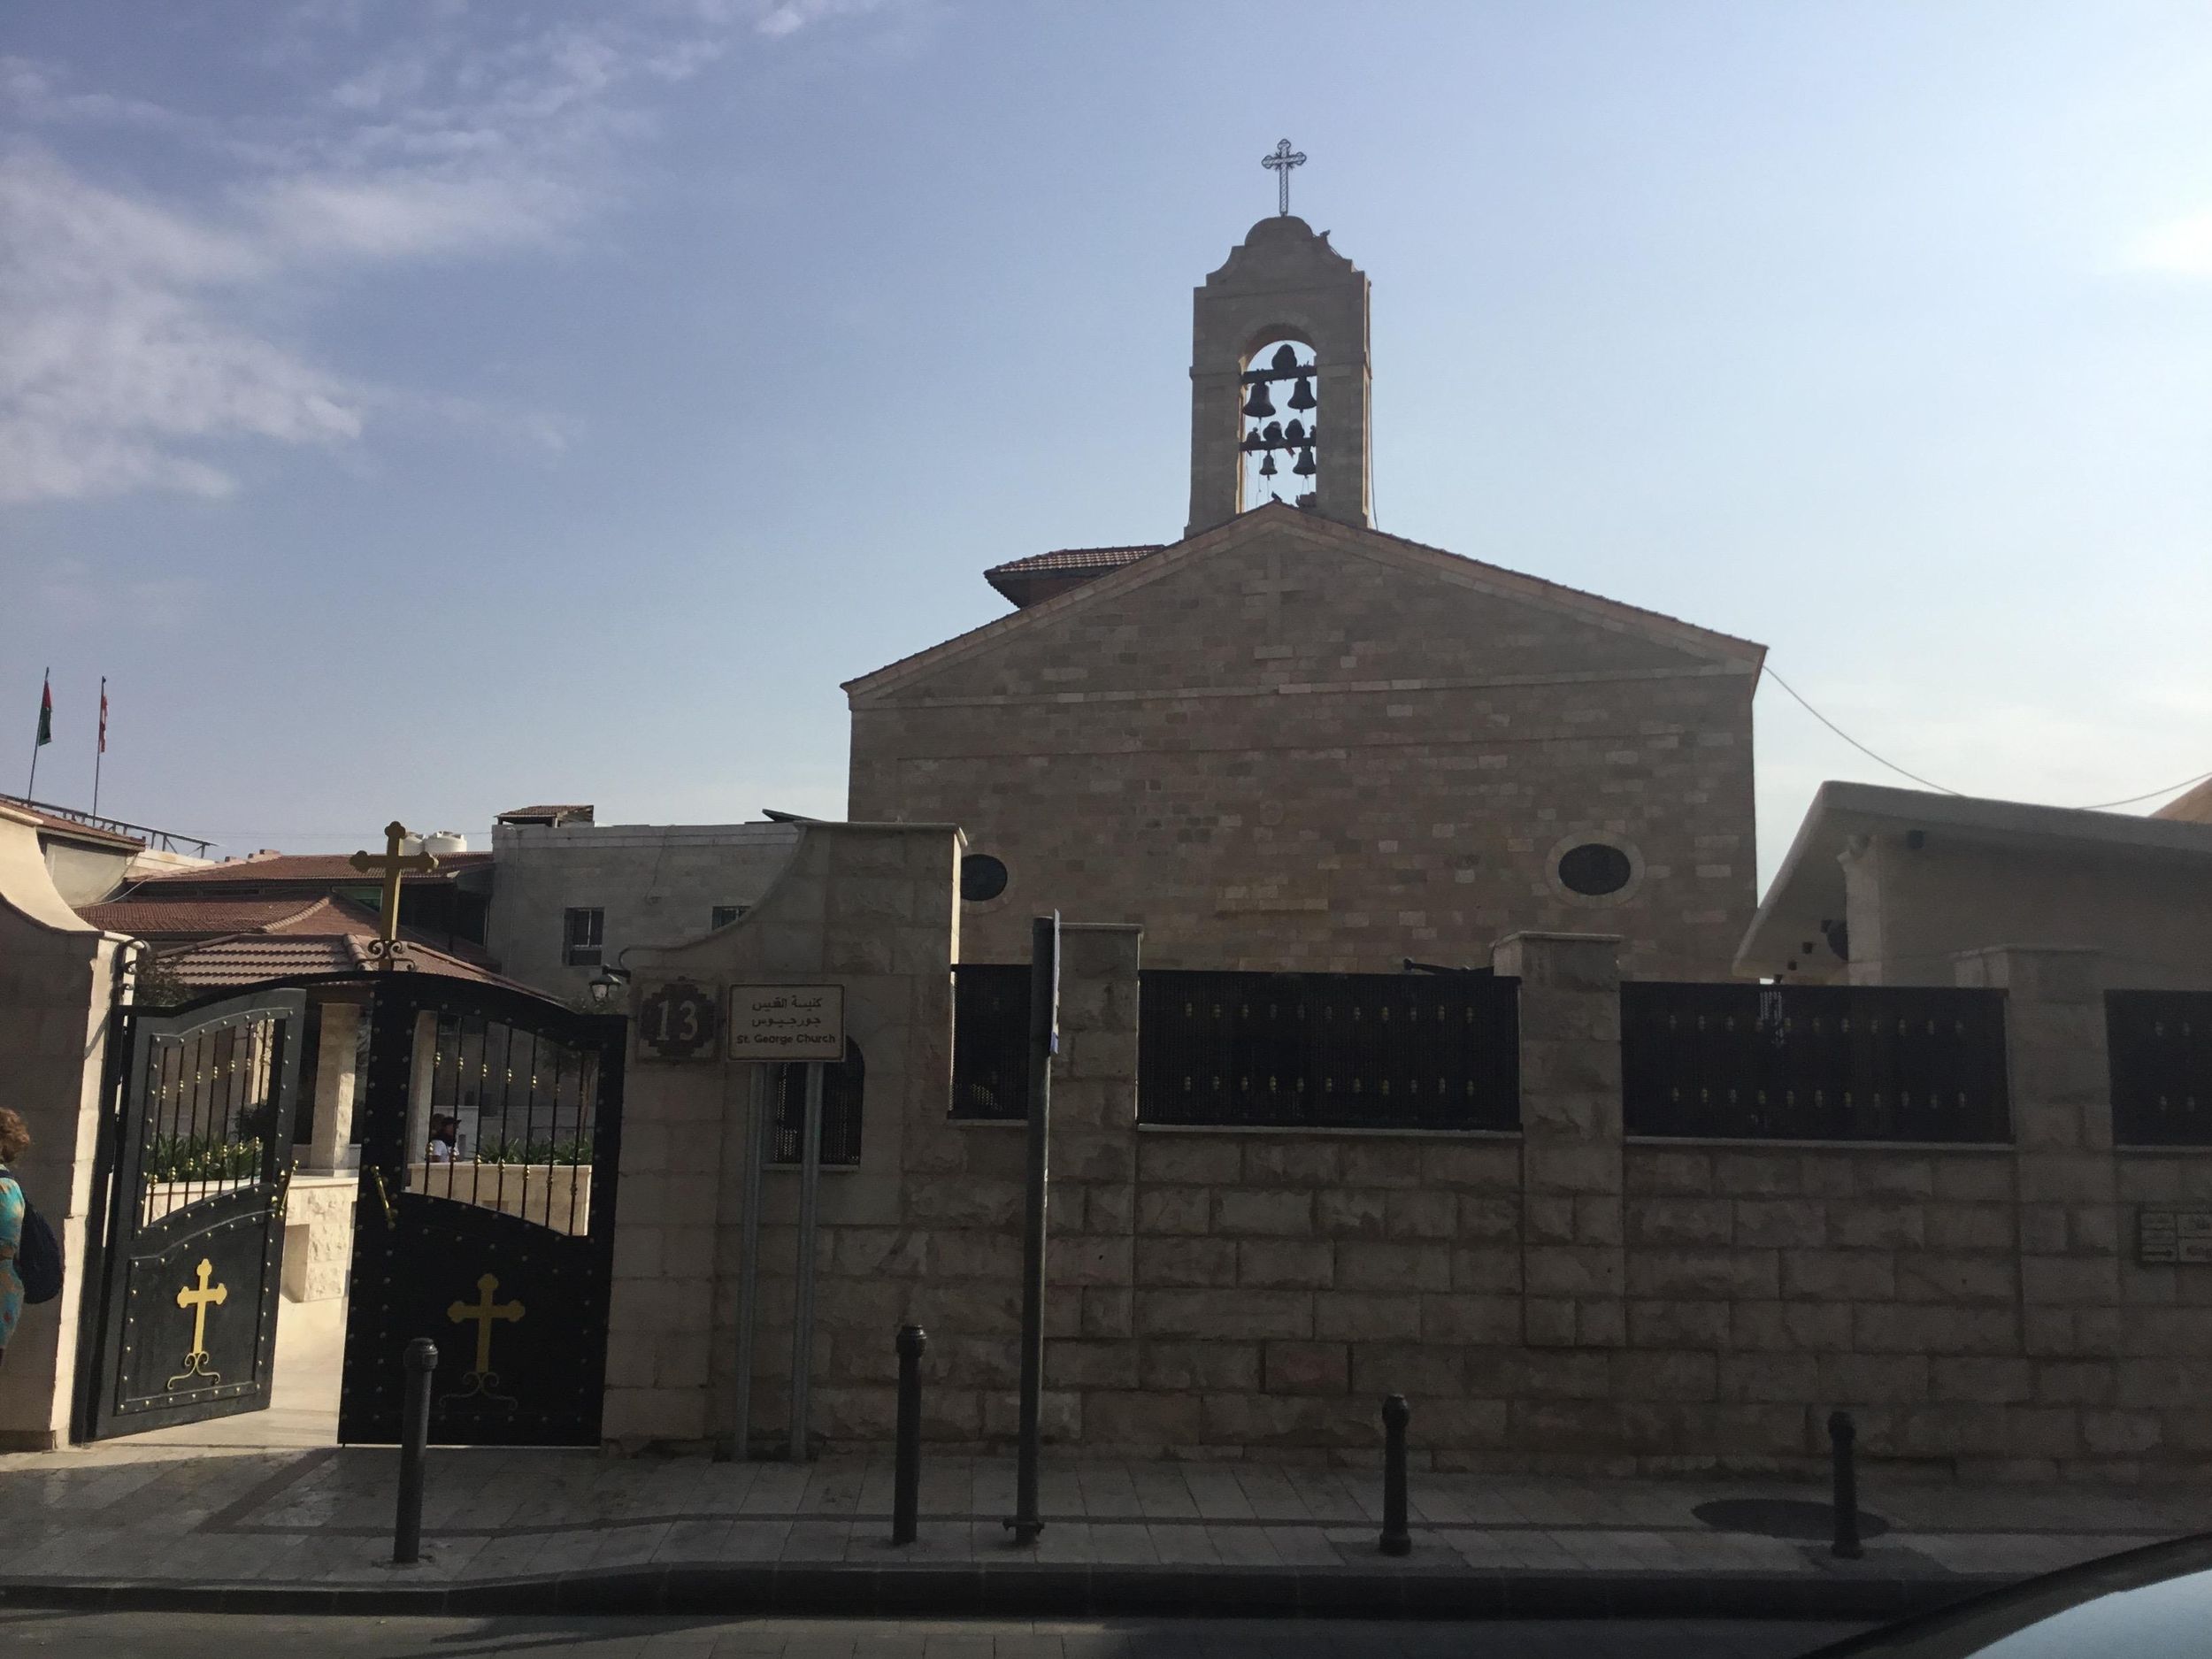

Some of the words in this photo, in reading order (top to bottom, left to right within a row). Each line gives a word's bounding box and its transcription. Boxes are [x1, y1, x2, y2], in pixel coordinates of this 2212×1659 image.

[792, 995, 823, 1011] كنيسة
[657, 1000, 698, 1041] 13
[752, 1018, 821, 1028] جورجيوس
[736, 1034, 750, 1044] St.
[754, 1033, 793, 1046] George
[796, 1033, 836, 1044] Church
